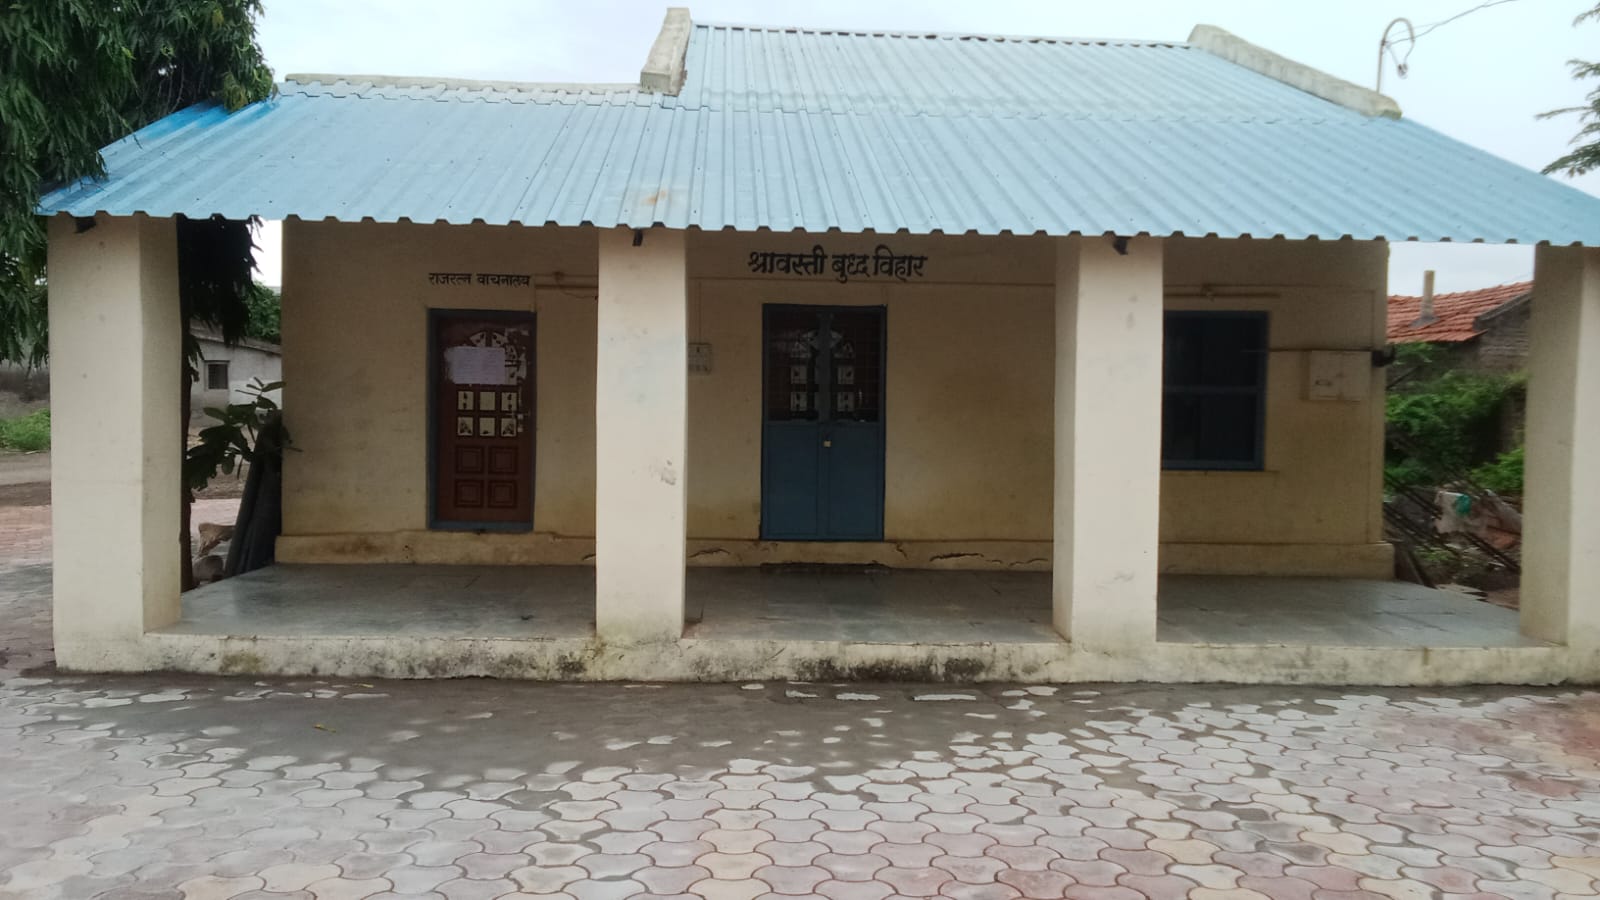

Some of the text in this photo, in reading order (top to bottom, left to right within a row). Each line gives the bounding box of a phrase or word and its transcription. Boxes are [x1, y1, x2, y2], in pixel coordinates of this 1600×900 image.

[748, 244, 828, 276] श्रावस्ती
[872, 244, 928, 283] विहार
[428, 272, 530, 286] राजरत्न वाचनालय
